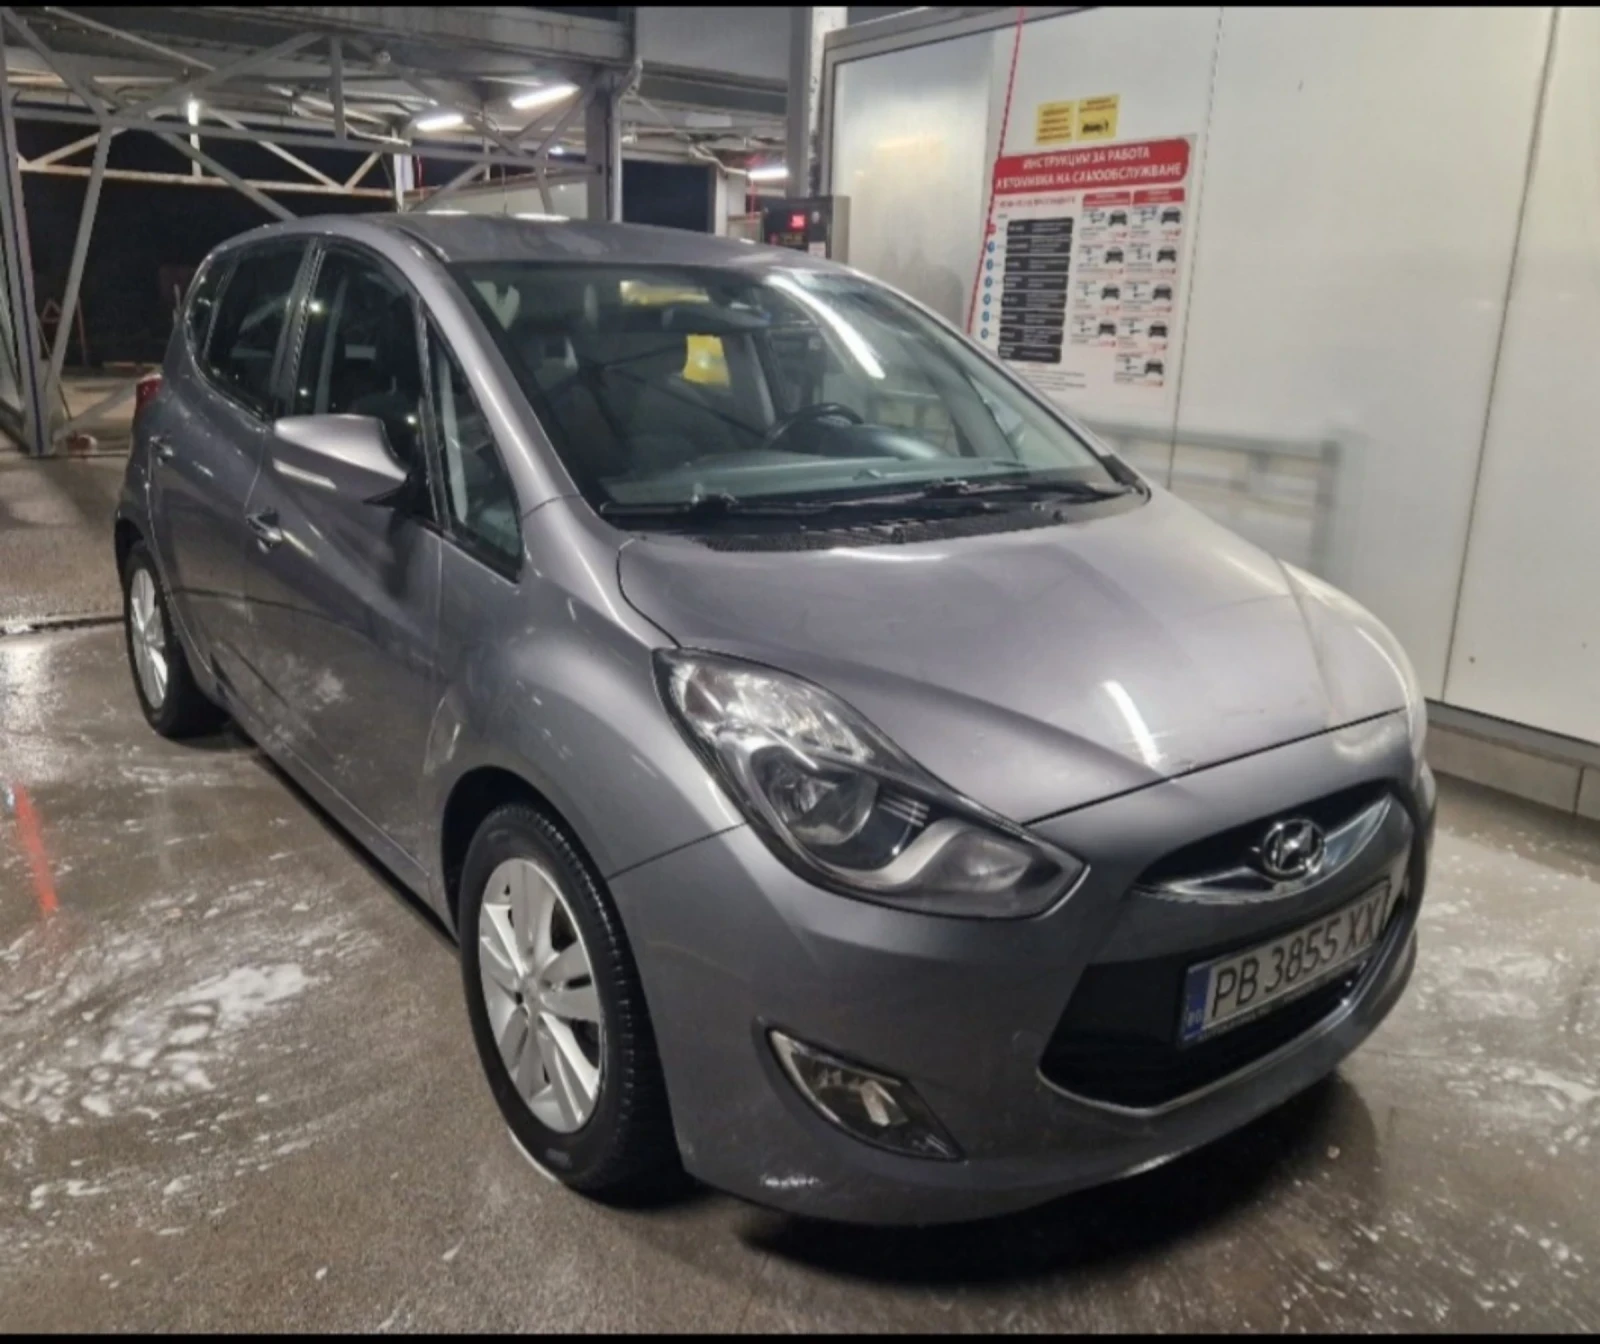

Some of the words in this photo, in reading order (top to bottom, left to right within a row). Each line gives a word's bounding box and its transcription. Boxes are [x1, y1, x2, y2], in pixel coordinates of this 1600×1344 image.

[1023, 152, 1091, 170] ИНСТРУКЦИИ
[1091, 149, 1106, 163] ЗА
[1107, 146, 1150, 161] РАБОТА
[1056, 171, 1071, 185] НА
[1072, 162, 1182, 184] САМООБСЛУЖВАНЕ
[1212, 957, 1259, 1018] PB
[1264, 916, 1341, 994] 3855
